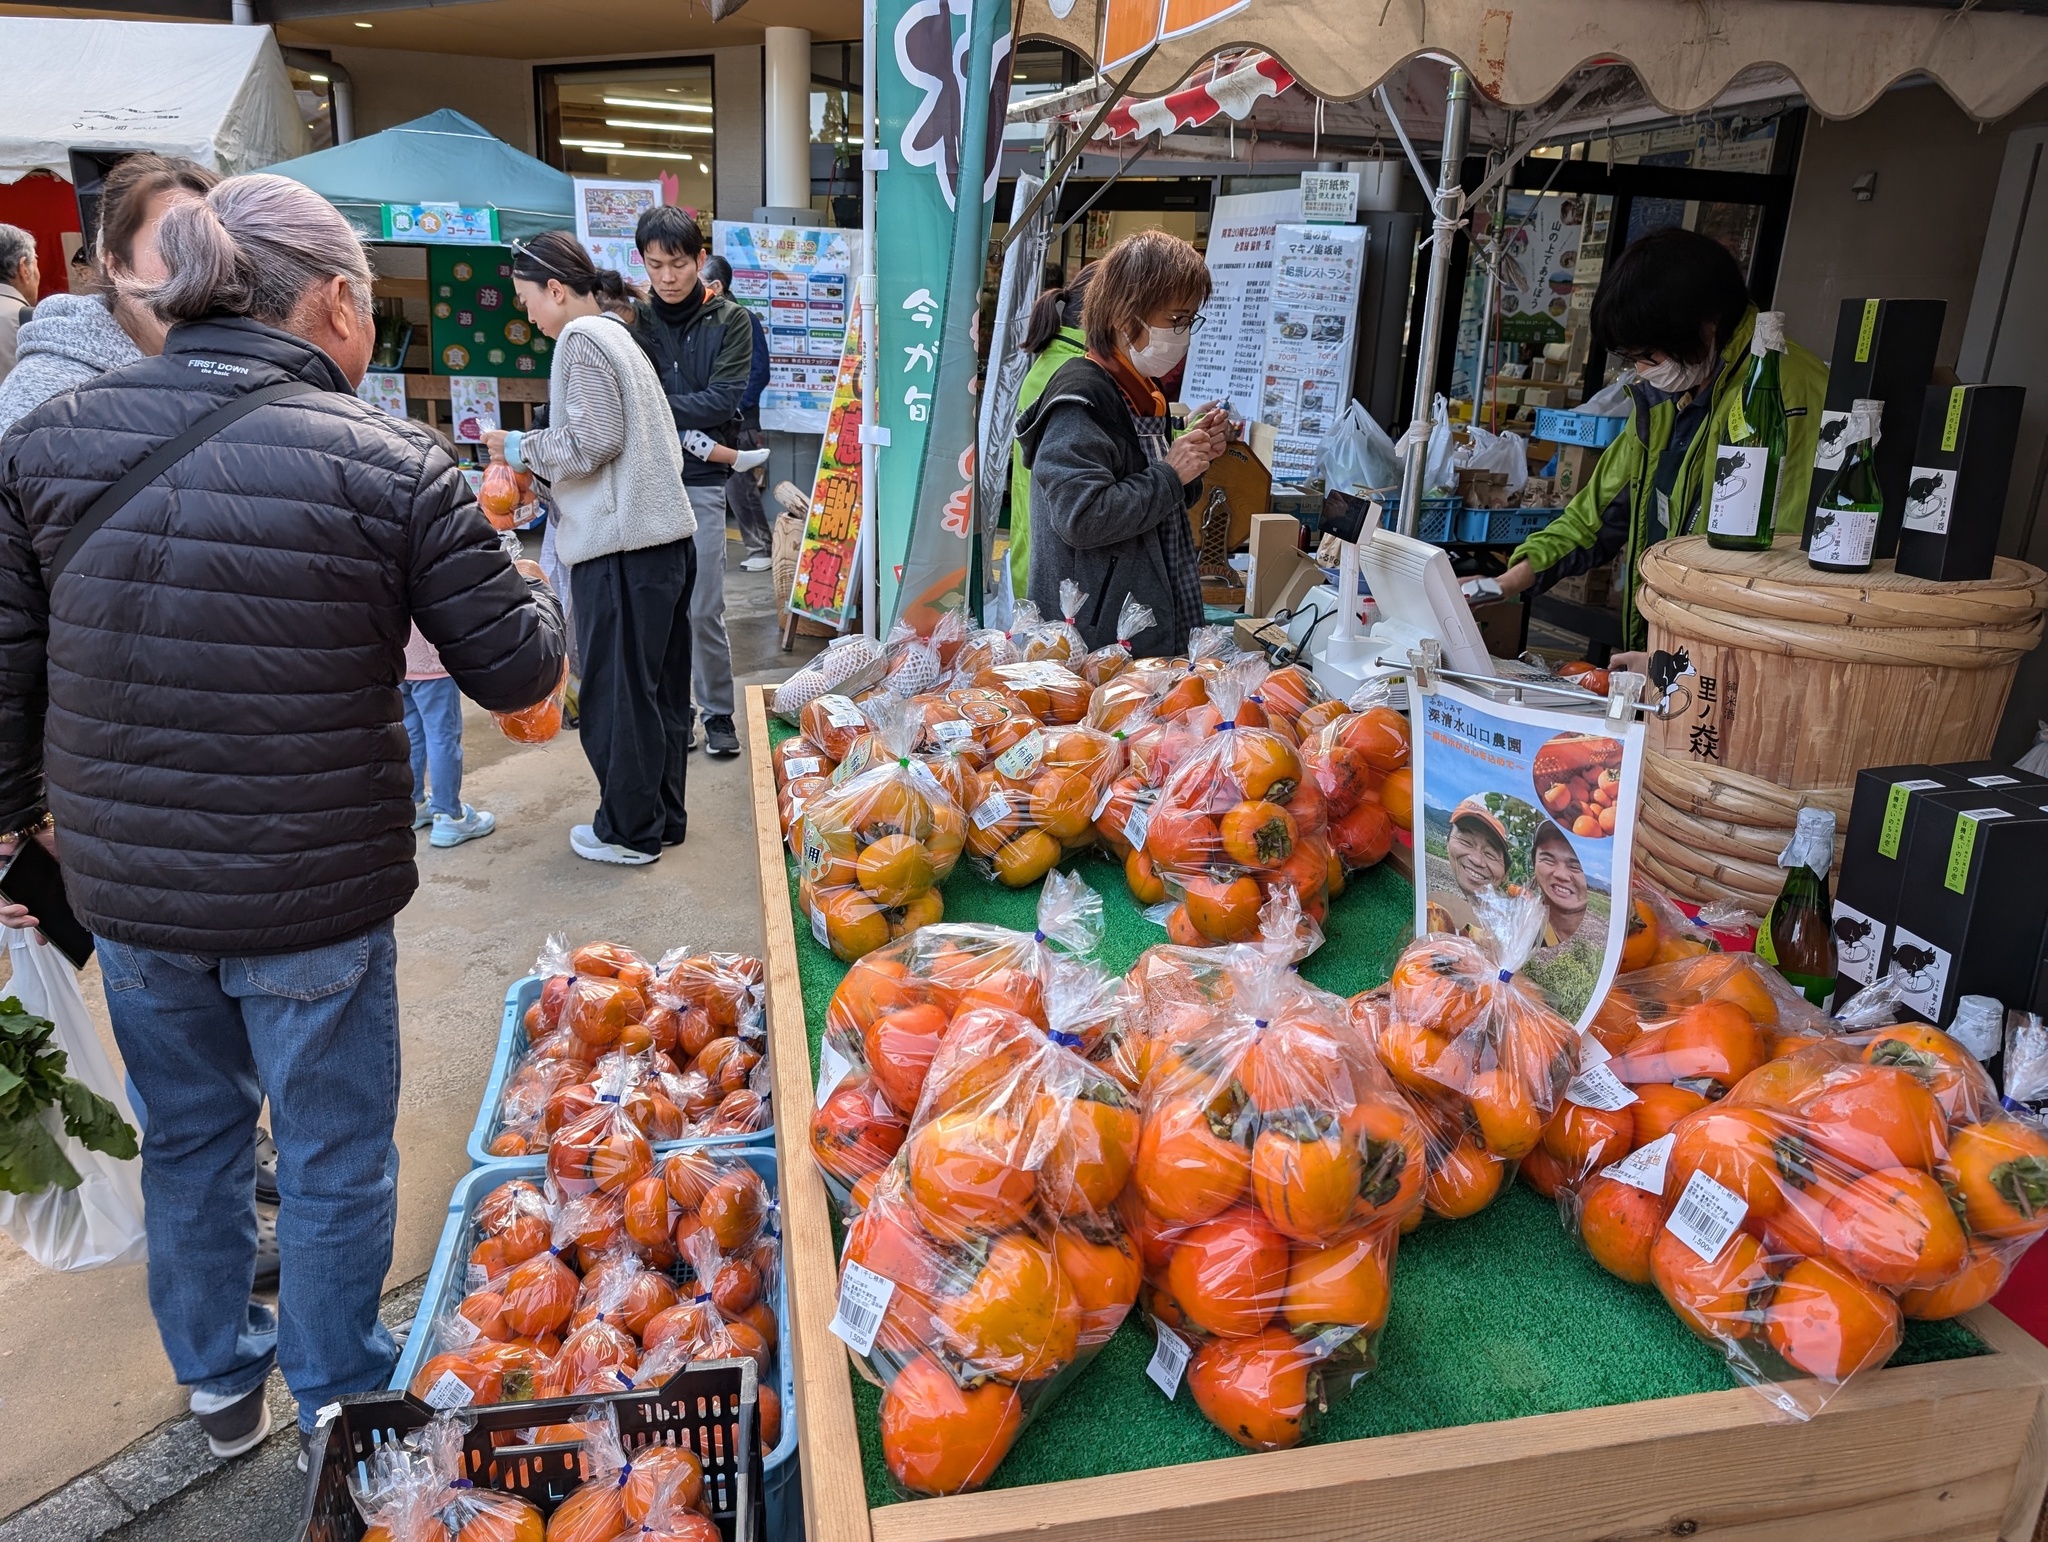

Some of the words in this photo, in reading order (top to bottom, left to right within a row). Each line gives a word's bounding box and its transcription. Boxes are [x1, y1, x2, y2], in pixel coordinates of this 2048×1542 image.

[1318, 179, 1349, 191] 新紙幣
[1318, 192, 1347, 200] 使えません
[423, 216, 438, 230] 食
[445, 212, 474, 222] ゲーム
[447, 226, 486, 236] コーナー
[761, 239, 817, 252] 20周年記念
[1289, 244, 1343, 256] マキノ追坂峠
[760, 252, 818, 265] セールご案内
[1531, 220, 1562, 309] 山の上であそぼう
[509, 323, 526, 341] 食
[447, 348, 465, 366] 食
[188, 360, 217, 369] FIRST
[217, 363, 249, 375] DOWN
[1429, 697, 1462, 716] ふかしみず
[1724, 680, 1738, 721] 純米酒
[1427, 705, 1522, 755] 深清水山口農園
[1691, 1234, 1714, 1254] 1,500円
[849, 1331, 868, 1348] 1,500円
